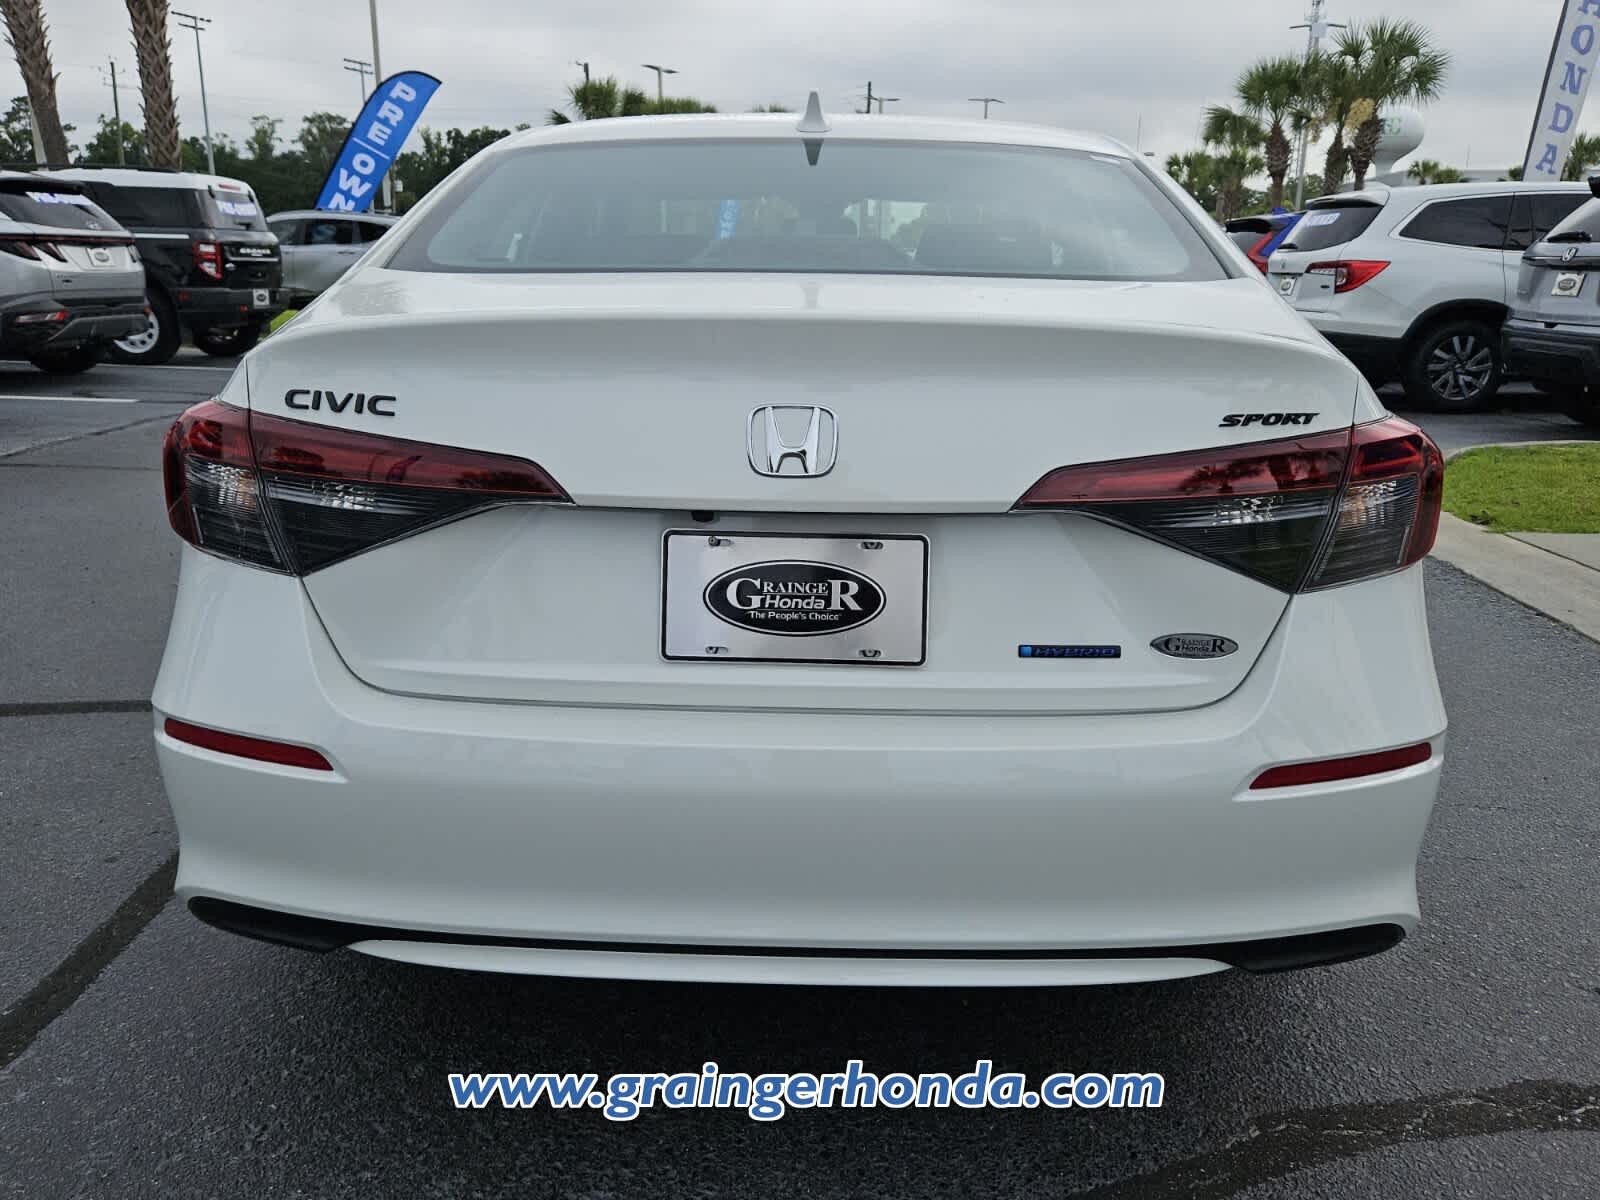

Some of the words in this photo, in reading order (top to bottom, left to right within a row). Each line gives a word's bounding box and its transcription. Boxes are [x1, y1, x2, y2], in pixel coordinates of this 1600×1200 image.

[367, 81, 417, 147] PRE
[284, 389, 397, 417] CIVIC
[1218, 412, 1321, 428] SPORT
[726, 577, 863, 611] GRAINGER
[764, 595, 825, 610] Honda
[749, 610, 766, 620] The
[767, 611, 807, 622] People's
[808, 612, 840, 622] Choice
[1035, 647, 1115, 656] HYBRID
